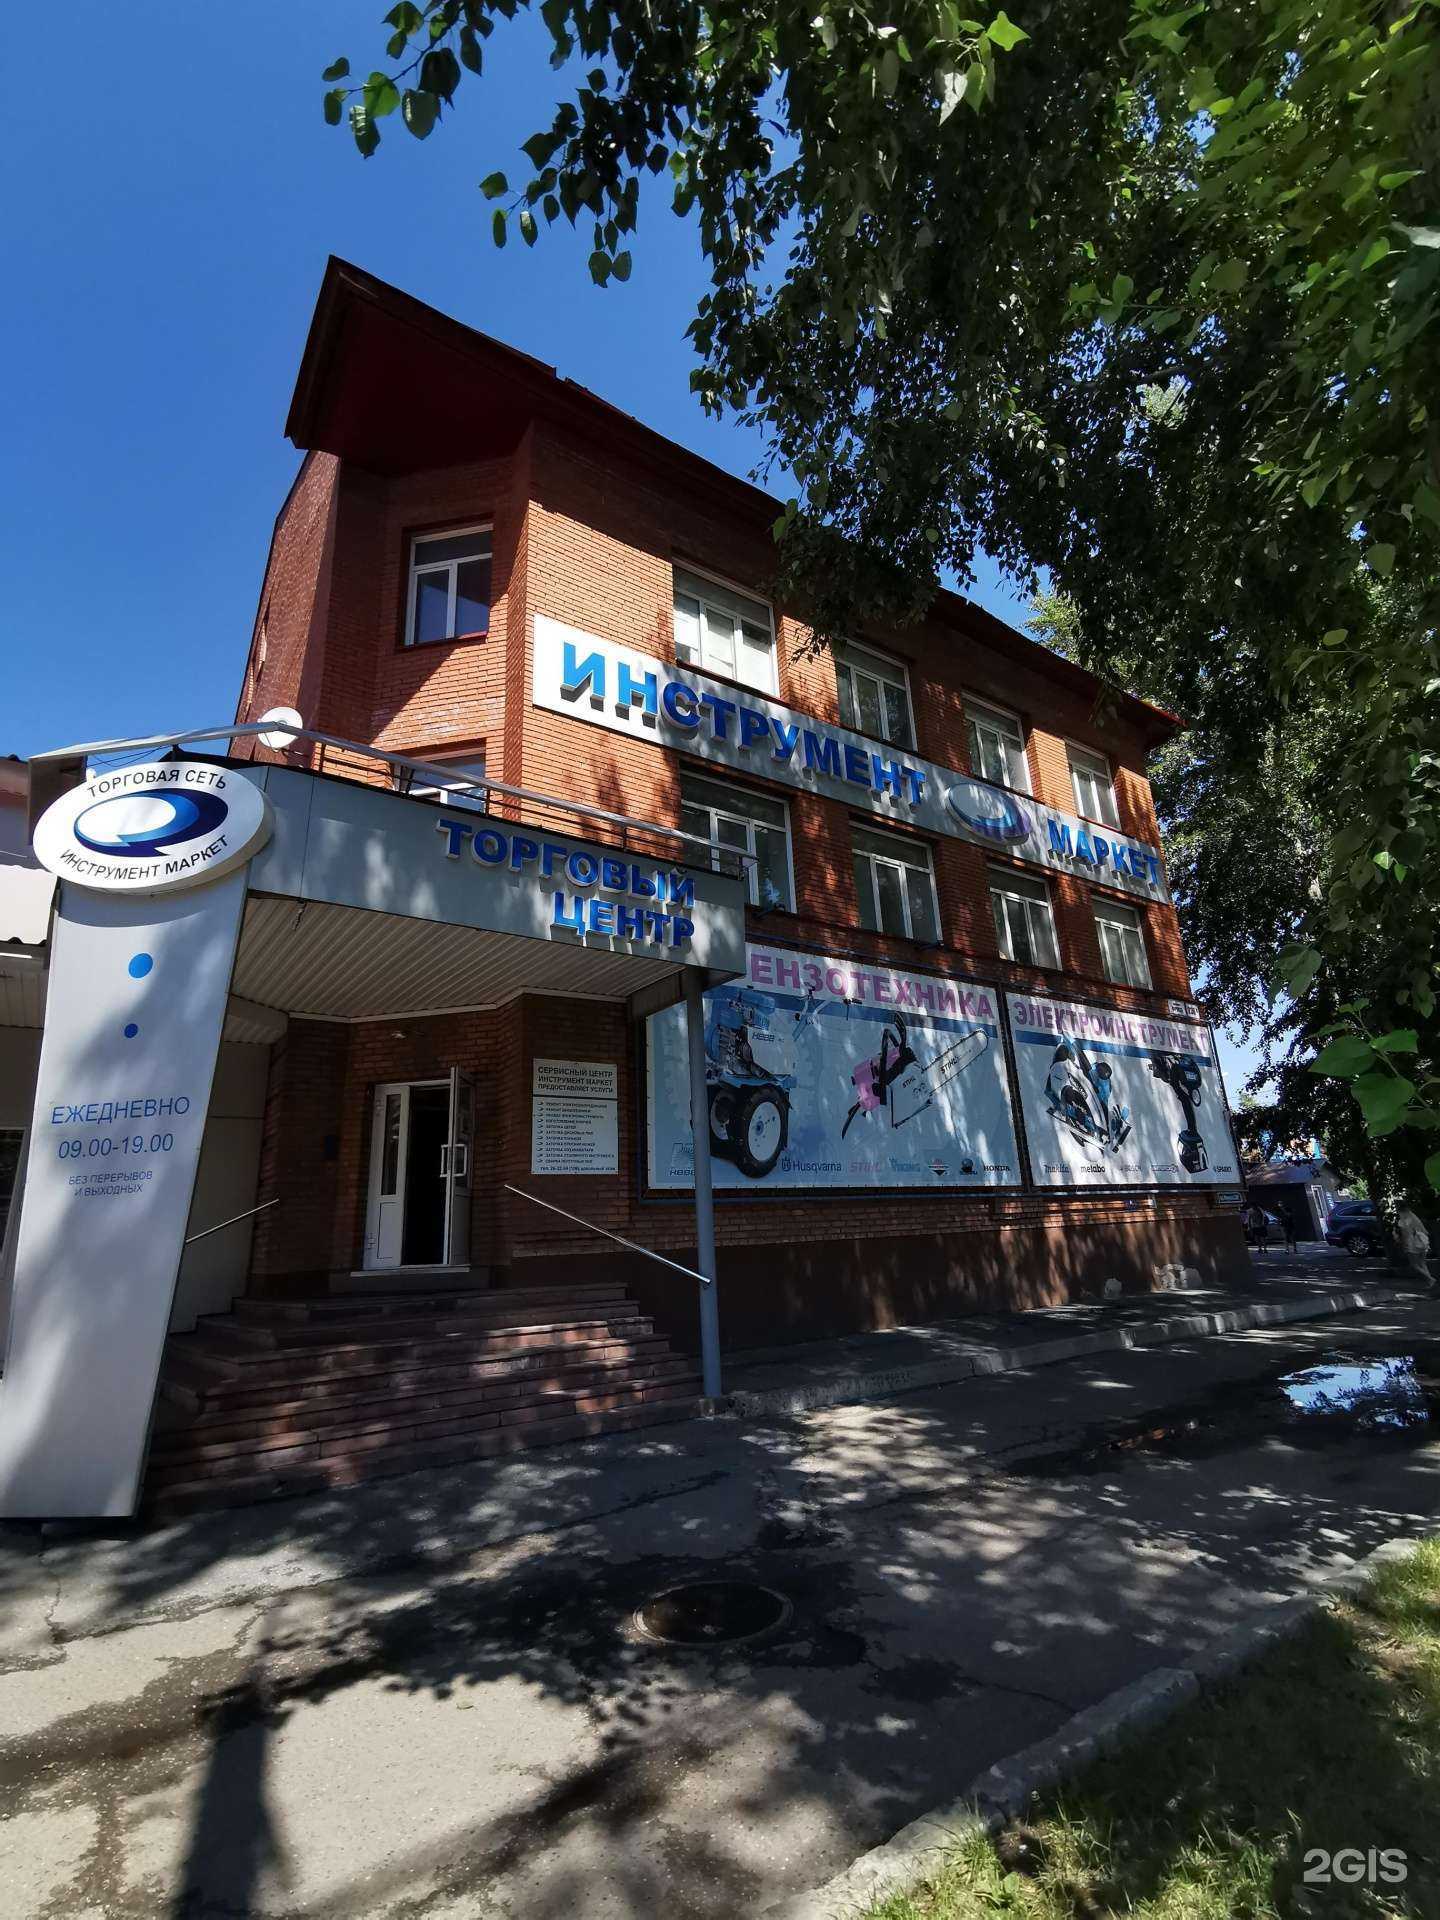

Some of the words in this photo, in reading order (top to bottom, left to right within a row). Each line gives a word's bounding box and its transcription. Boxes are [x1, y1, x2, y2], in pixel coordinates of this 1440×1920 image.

[561, 641, 926, 808] ИНСТРУМЕНТ
[1046, 818, 1159, 888] МАРКЕТ
[87, 769, 180, 798] ТОРГОВАЯ
[185, 769, 228, 791] СЕТЬ
[59, 849, 159, 880] ИНСТРУМЕНТ
[164, 835, 229, 874] МАРКЕТ
[437, 819, 696, 909] ТОРГОВЫЙ
[551, 891, 695, 948] ЦЕНТР
[749, 952, 995, 1019] ЕНЗОТЕХНИКА
[1014, 1001, 1209, 1051] ЭЛЕКТРОИНСТРУМЕНТ
[538, 1066, 587, 1076] СЕРВИСНЫЙ
[589, 1070, 613, 1078] ЦЕНТР
[538, 1075, 584, 1085] ИНСТРУМЕНТ
[586, 1078, 613, 1086] МАРКЕТ
[51, 1096, 191, 1125] ЕЖЕДНЕВНО
[58, 1133, 174, 1159] 09.00-19.00
[68, 1175, 88, 1187] БЕЗ
[89, 1170, 153, 1185] ПЕРЕРЫВОВ
[793, 1160, 842, 1174] Husqvarna
[1080, 1164, 1106, 1173] metabo
[74, 1185, 83, 1197] И
[84, 1183, 144, 1197] ВЫХОДНЫХ
